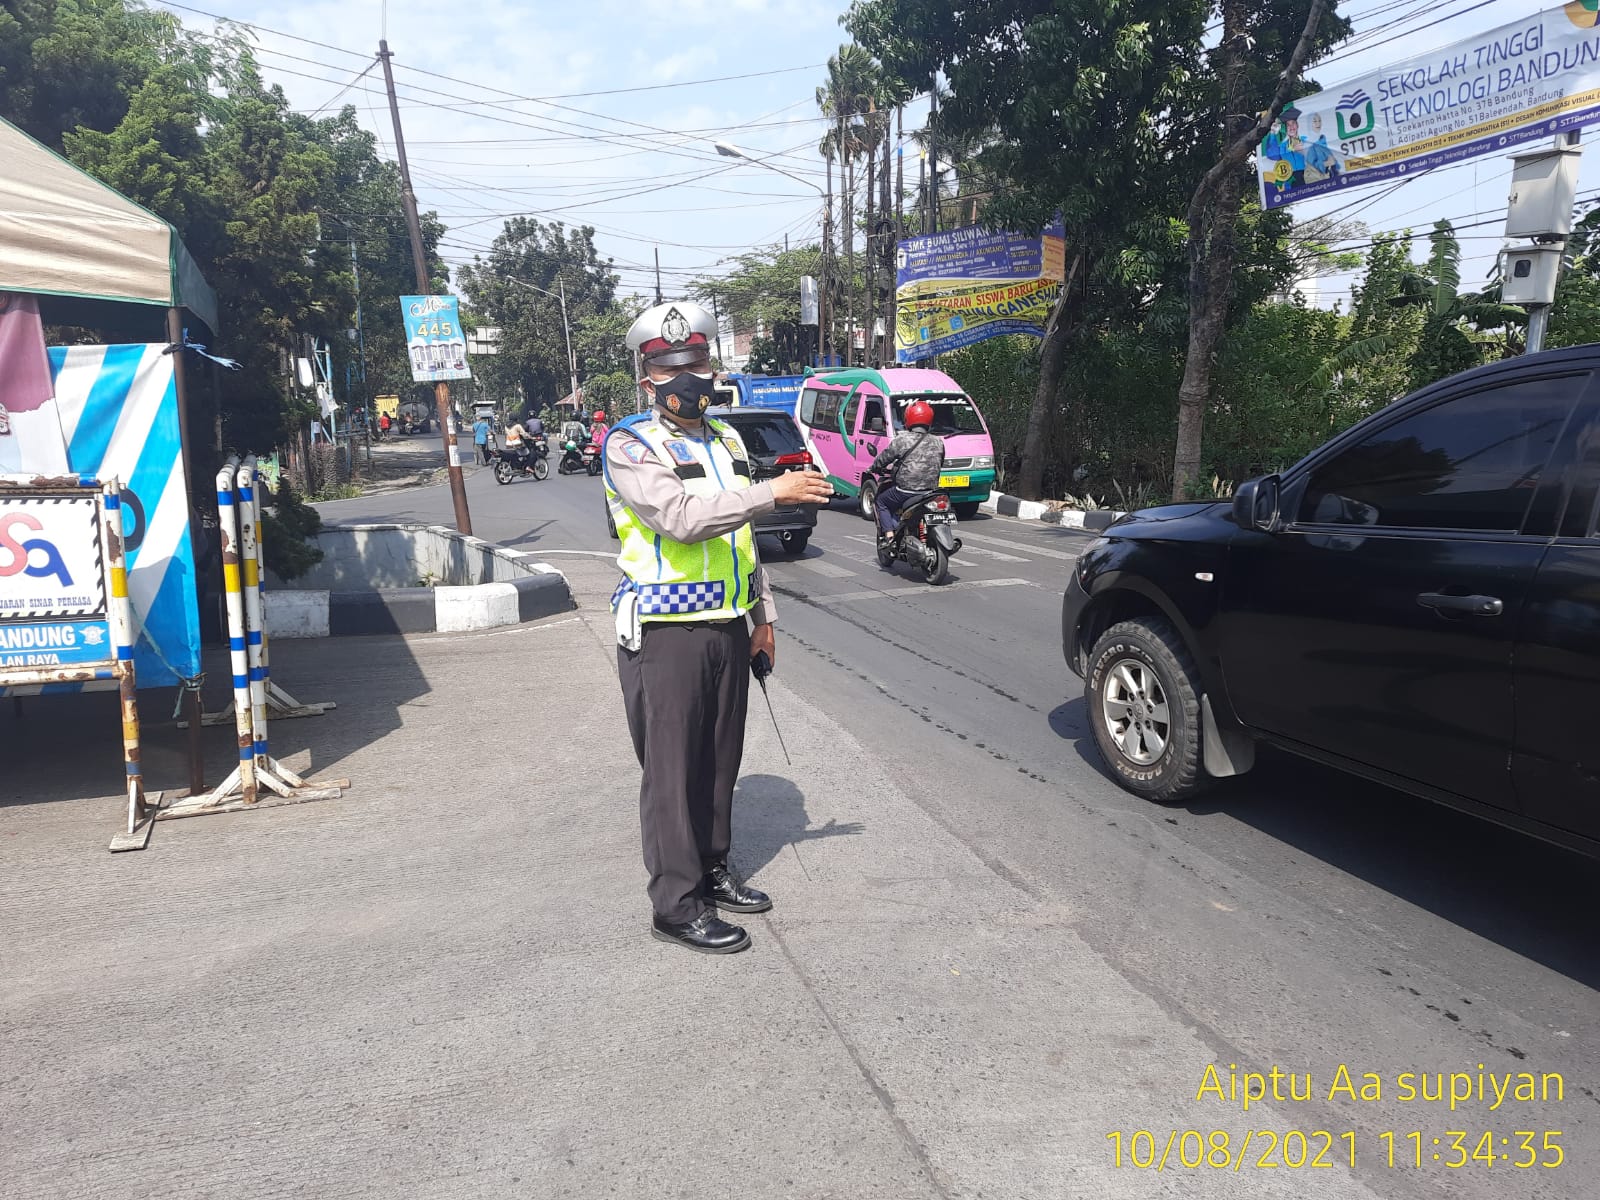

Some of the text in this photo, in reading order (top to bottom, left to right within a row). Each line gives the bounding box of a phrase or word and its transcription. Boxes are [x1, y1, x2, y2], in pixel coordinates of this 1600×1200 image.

[1378, 23, 1543, 101] SEKOLAH TINGGI
[1380, 73, 1491, 128] TEKNOLOGI
[1571, 93, 1596, 105] VISUAL
[1396, 118, 1435, 134] Soekarno
[1435, 110, 1460, 121] Hatta
[1495, 87, 1534, 105] Bandung
[1398, 130, 1427, 145] Adipati
[1428, 123, 1453, 136] Agung
[1528, 88, 1565, 106] Bandung
[1340, 135, 1377, 156] STTB
[927, 235, 950, 248] BUMI
[976, 290, 1005, 306] SISWA
[1008, 282, 1033, 299] BARU
[417, 322, 452, 337] 445
[29, 597, 54, 609] SINAR
[58, 596, 92, 607] PERKASA
[28, 653, 60, 665] RAYA
